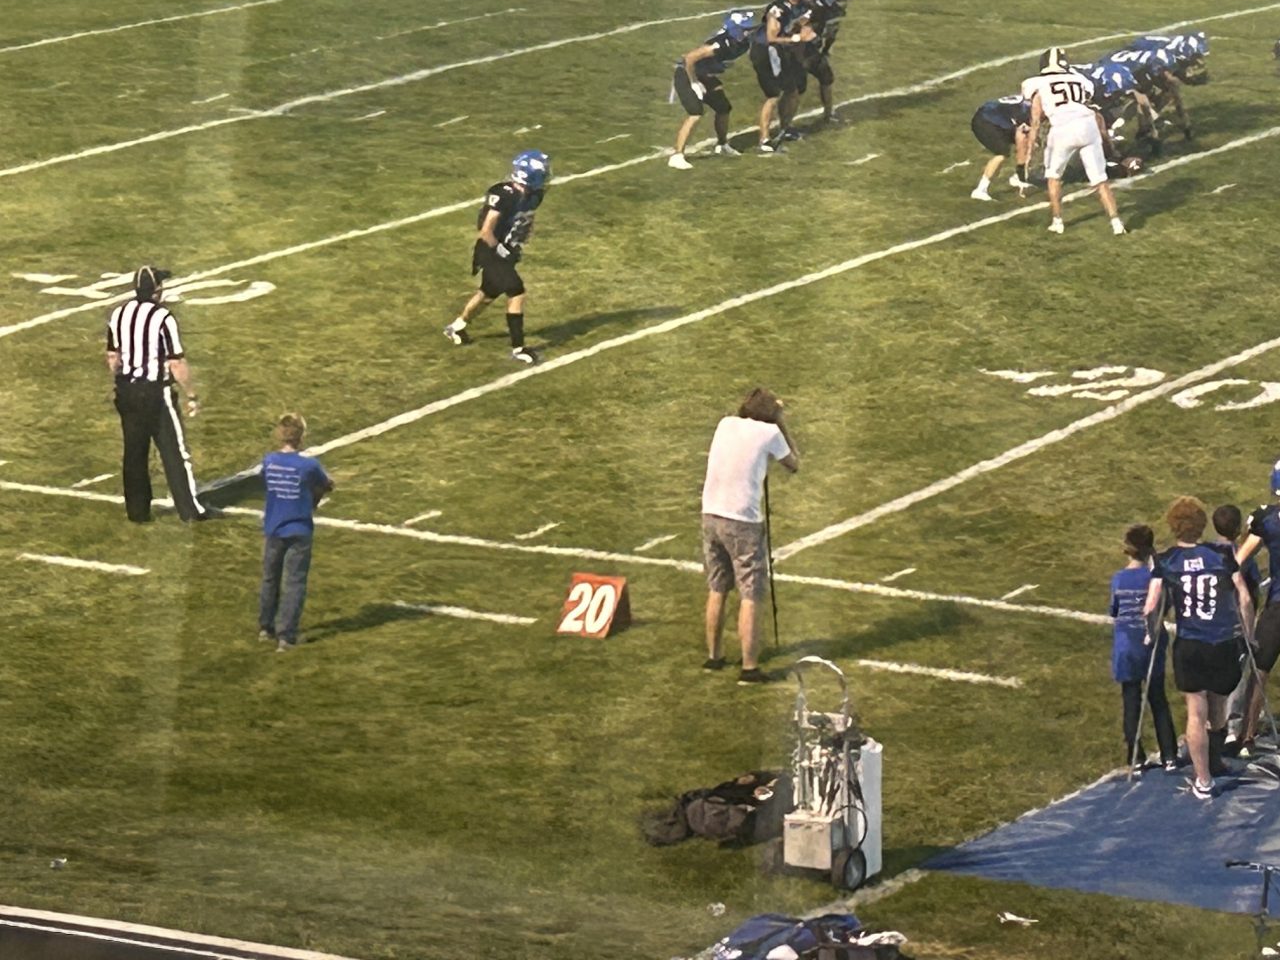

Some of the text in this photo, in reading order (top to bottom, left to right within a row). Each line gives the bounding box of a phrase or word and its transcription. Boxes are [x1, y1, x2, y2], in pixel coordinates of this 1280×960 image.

[1050, 80, 1084, 107] 50
[557, 582, 616, 633] 20
[1180, 574, 1218, 621] 10
